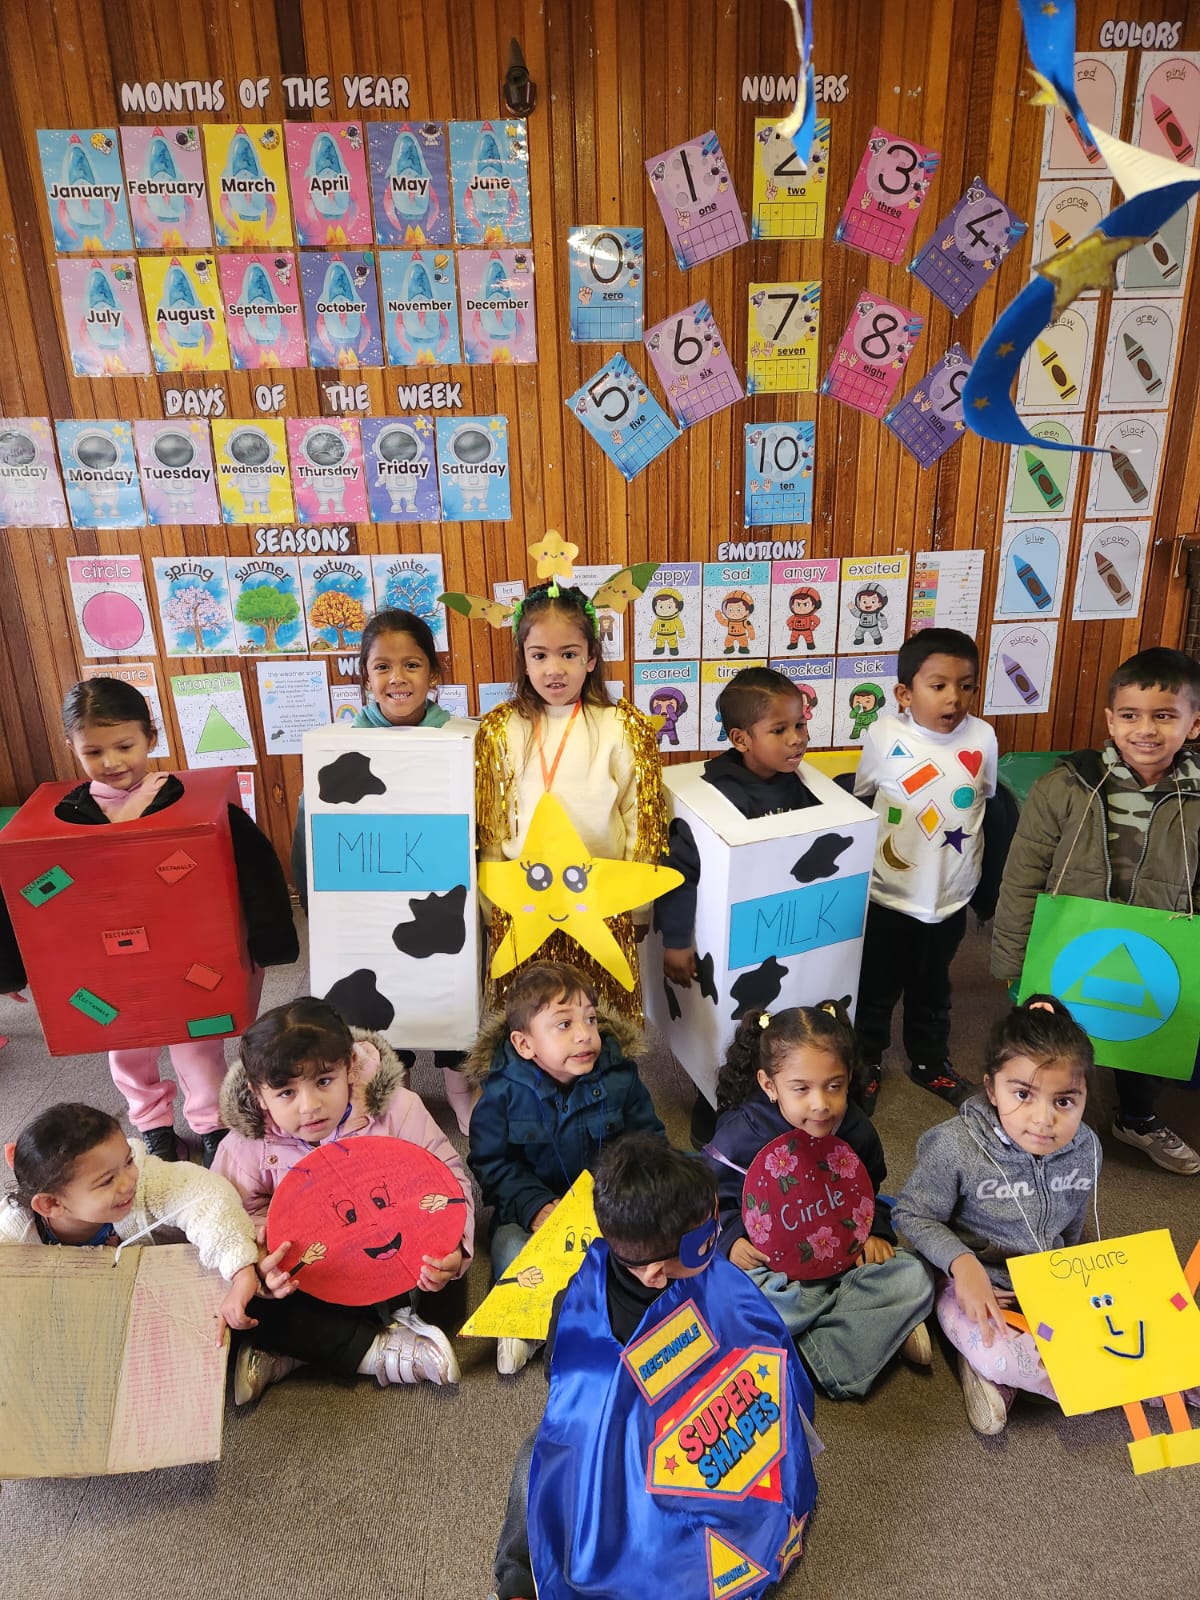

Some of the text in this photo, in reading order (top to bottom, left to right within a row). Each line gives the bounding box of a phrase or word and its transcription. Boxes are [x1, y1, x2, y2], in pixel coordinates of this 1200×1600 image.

[1100, 20, 1183, 49] COLORS
[1077, 67, 1097, 79] red
[1166, 66, 1186, 79] pink
[121, 75, 411, 112] MONTHS OF THE YEAR
[741, 74, 849, 103] NUMERS
[679, 149, 697, 202] 1
[878, 144, 918, 195] 3
[129, 180, 204, 199] February
[222, 178, 275, 194] March
[310, 175, 350, 195] April
[392, 177, 428, 196] May
[470, 175, 511, 191] June
[787, 186, 806, 196] two
[50, 183, 121, 202] January
[698, 201, 718, 215] one
[877, 200, 903, 217] three
[1055, 196, 1089, 210] orange
[966, 207, 1004, 248] 4
[590, 233, 623, 284] 0
[957, 250, 975, 270] four
[466, 298, 529, 311] December
[602, 291, 624, 301] zero
[156, 307, 215, 323] August
[228, 303, 298, 318] September
[316, 301, 367, 314] October
[388, 300, 453, 313] November
[86, 308, 122, 327] July
[767, 293, 799, 341] 7
[1136, 312, 1159, 325] grey
[673, 319, 702, 365] 6
[861, 313, 899, 359] 8
[777, 346, 806, 356] seven
[699, 366, 713, 379] six
[863, 362, 887, 381] eight
[165, 382, 462, 416] DAYS OF THE WEEK
[589, 371, 630, 423] 5
[629, 413, 647, 431] five
[930, 413, 947, 433] nine
[1120, 426, 1145, 436] black
[759, 436, 799, 474] 10
[0, 466, 48, 480] unday
[69, 468, 134, 484] Monday
[144, 466, 211, 483] Tuesday
[221, 464, 286, 477] Wednesday
[297, 465, 359, 480] Thursday
[378, 461, 429, 478] Friday
[442, 462, 507, 478] Saturday
[779, 480, 795, 491] ten
[256, 527, 350, 554] SEASONS
[1025, 533, 1046, 544] blue
[1100, 534, 1129, 546] brown
[717, 539, 807, 562] EMOTIONS
[81, 564, 131, 579] circle
[164, 559, 214, 582] spring
[235, 561, 291, 583] summer
[313, 560, 365, 580] autumn
[386, 560, 430, 577] winter
[722, 567, 750, 582] Sad
[783, 566, 827, 582] angry
[848, 562, 901, 577] excited
[651, 570, 692, 585] appy
[1009, 635, 1038, 646] purple
[642, 667, 690, 680] scared
[718, 665, 748, 677] tire
[855, 660, 883, 674] Sick
[176, 675, 234, 692] triangle
[333, 689, 359, 698] rainbow
[338, 832, 424, 874] MILK
[754, 890, 840, 952] MILK
[976, 1179, 1036, 1200] Can
[780, 1186, 846, 1231] Circle
[1049, 1250, 1129, 1288] Square
[638, 1322, 702, 1381] RECTANGLE
[678, 1370, 762, 1464] SUPER
[698, 1392, 781, 1488] SHAPES
[713, 1562, 752, 1589] TRIANGLE
